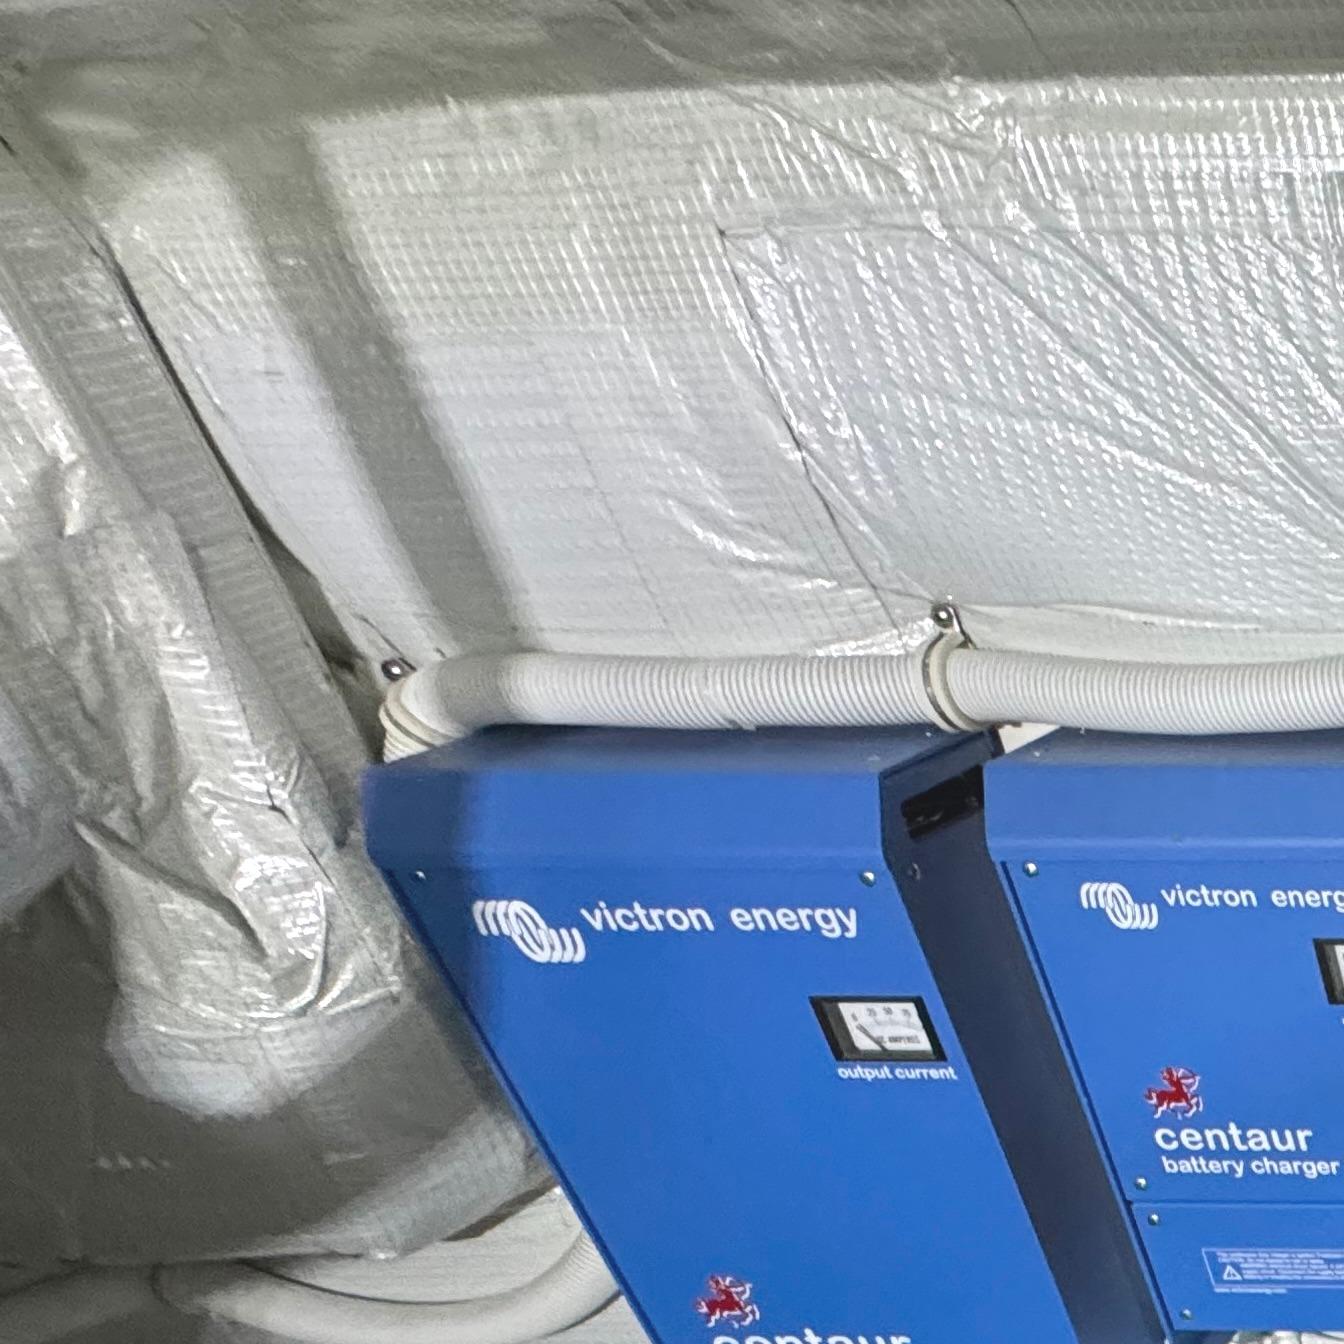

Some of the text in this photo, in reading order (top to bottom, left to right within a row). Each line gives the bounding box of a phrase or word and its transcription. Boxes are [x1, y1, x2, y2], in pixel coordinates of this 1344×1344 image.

[1161, 884, 1258, 908] victron
[581, 900, 858, 939] victron energy
[837, 1064, 958, 1082] output current
[1154, 1121, 1314, 1152] centaur
[1161, 1155, 1245, 1178] battery
[1251, 1156, 1339, 1179] charger
